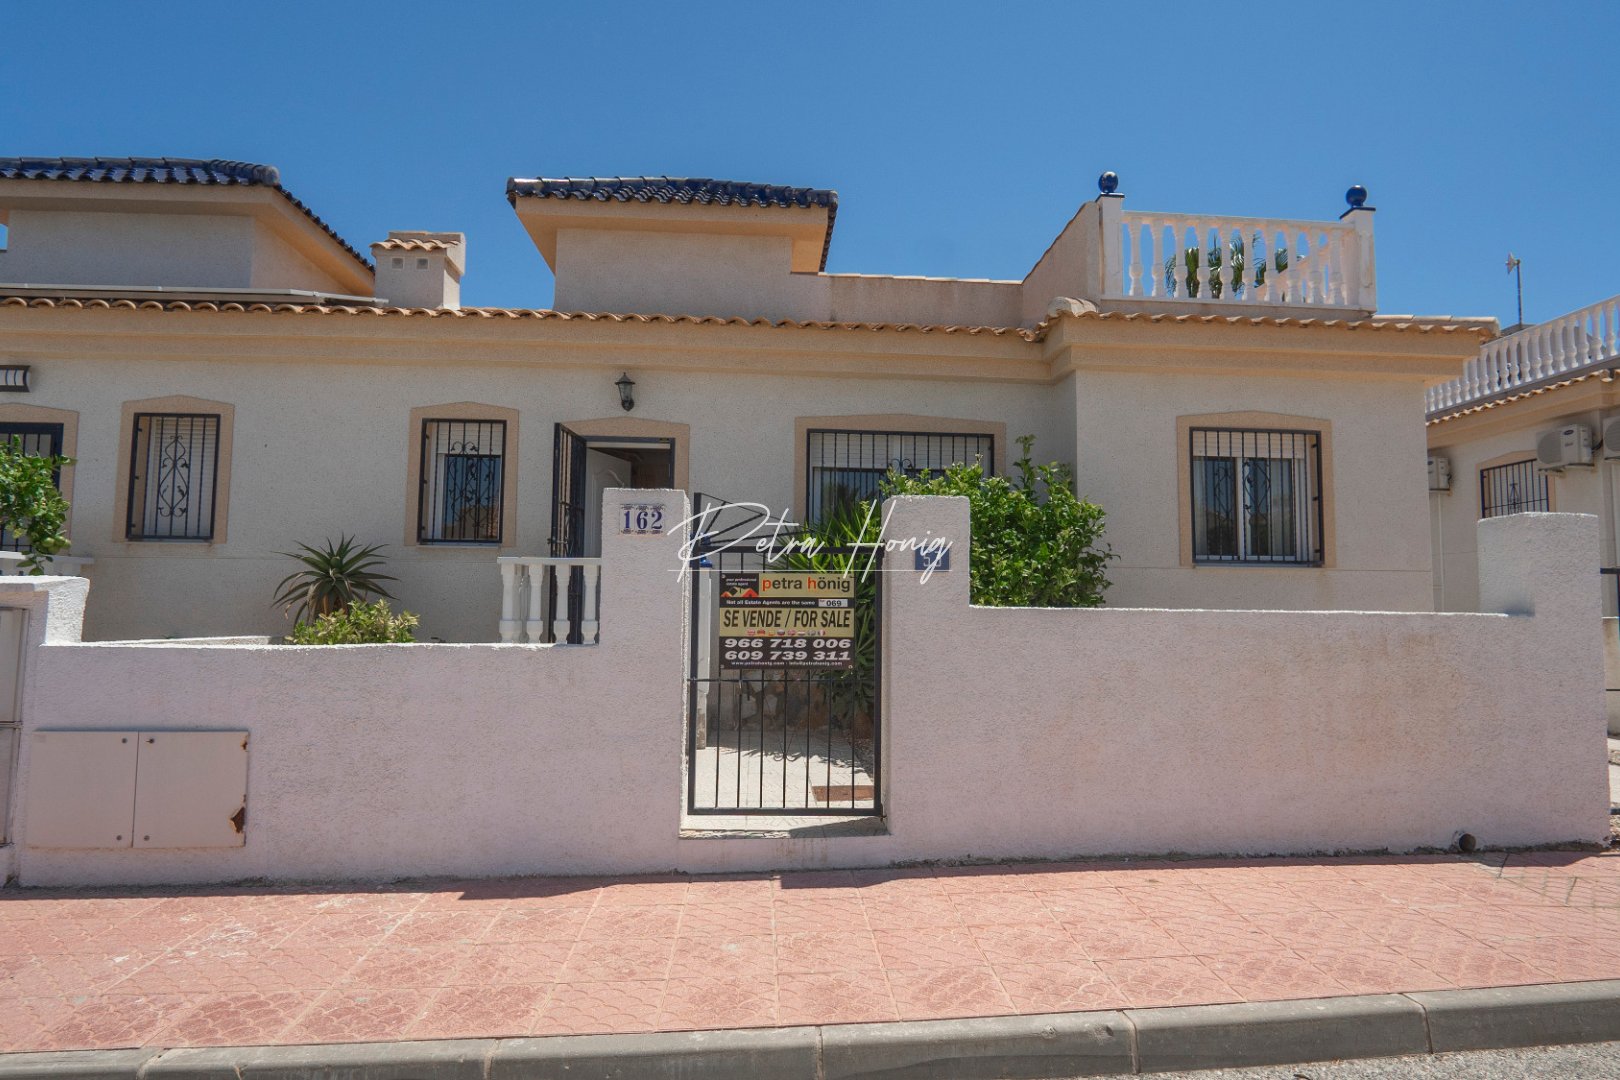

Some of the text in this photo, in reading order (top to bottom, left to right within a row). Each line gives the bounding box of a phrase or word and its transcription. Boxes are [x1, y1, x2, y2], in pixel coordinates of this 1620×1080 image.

[624, 510, 662, 529] 162
[762, 576, 850, 592] petra hönig
[723, 609, 740, 627] SE
[742, 610, 782, 628] VENDE
[794, 610, 818, 627] FOR
[820, 610, 851, 627] SALE
[724, 638, 851, 649] 966 718 006
[725, 650, 851, 661] 609 739 311
